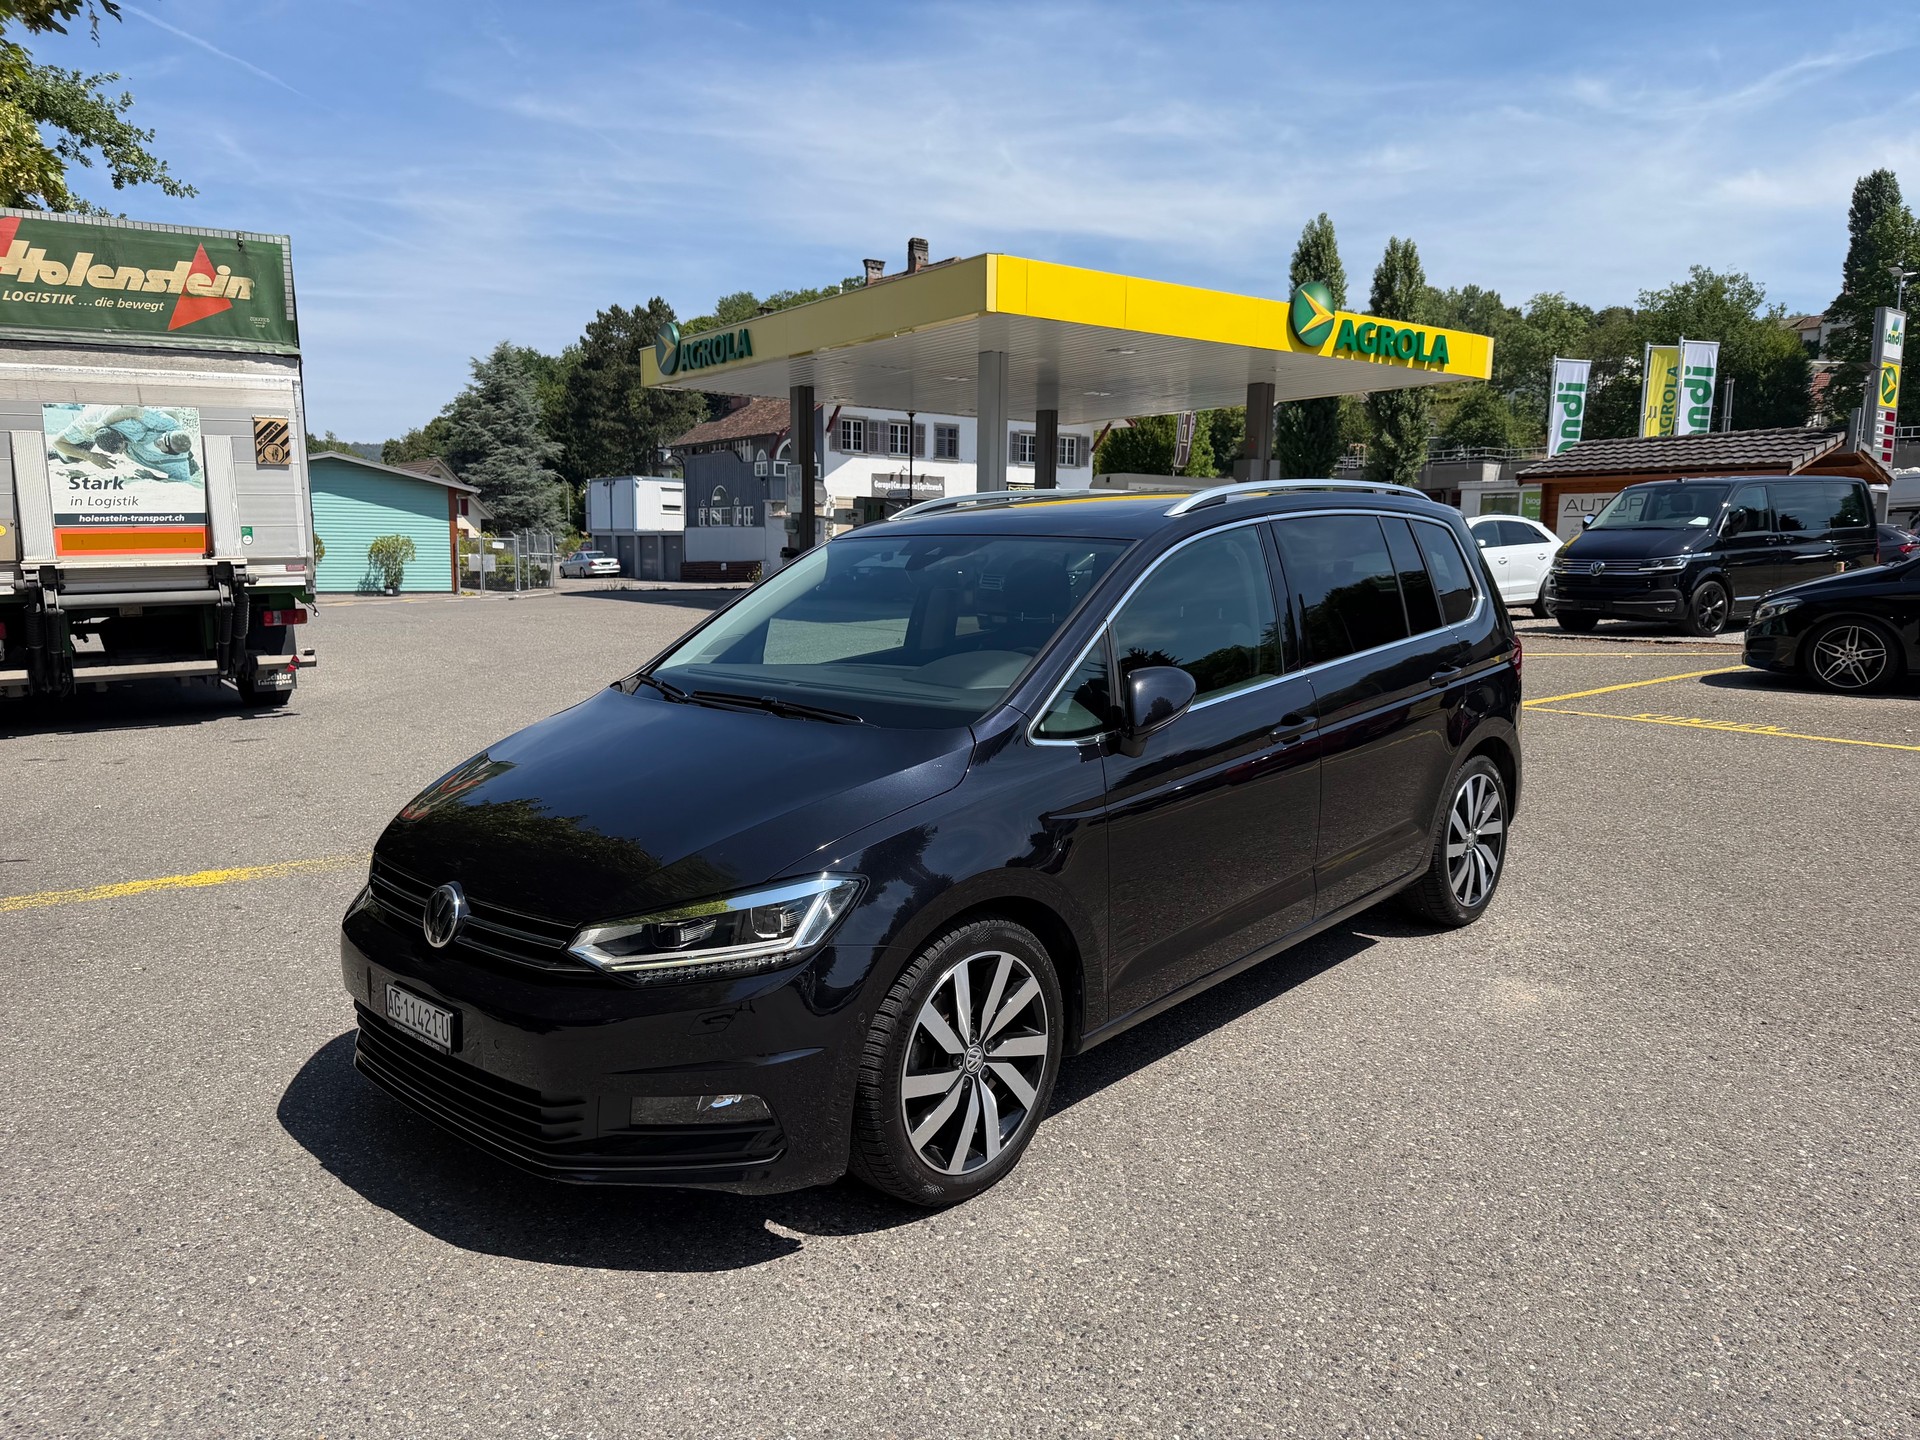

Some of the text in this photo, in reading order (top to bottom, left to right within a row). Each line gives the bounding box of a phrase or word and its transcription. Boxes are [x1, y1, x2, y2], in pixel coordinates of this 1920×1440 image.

[0, 240, 255, 300] Holenstein
[3, 290, 76, 305] LOGISTIK
[117, 298, 165, 313] bewegt
[679, 329, 752, 371] AGROLA
[1336, 319, 1449, 364] AGROLA
[1683, 365, 1715, 433] ndi
[69, 476, 124, 490] Stark
[70, 496, 139, 509] in Logistik
[1526, 497, 1540, 506] biog
[79, 514, 185, 523] holenstein-transport.ch
